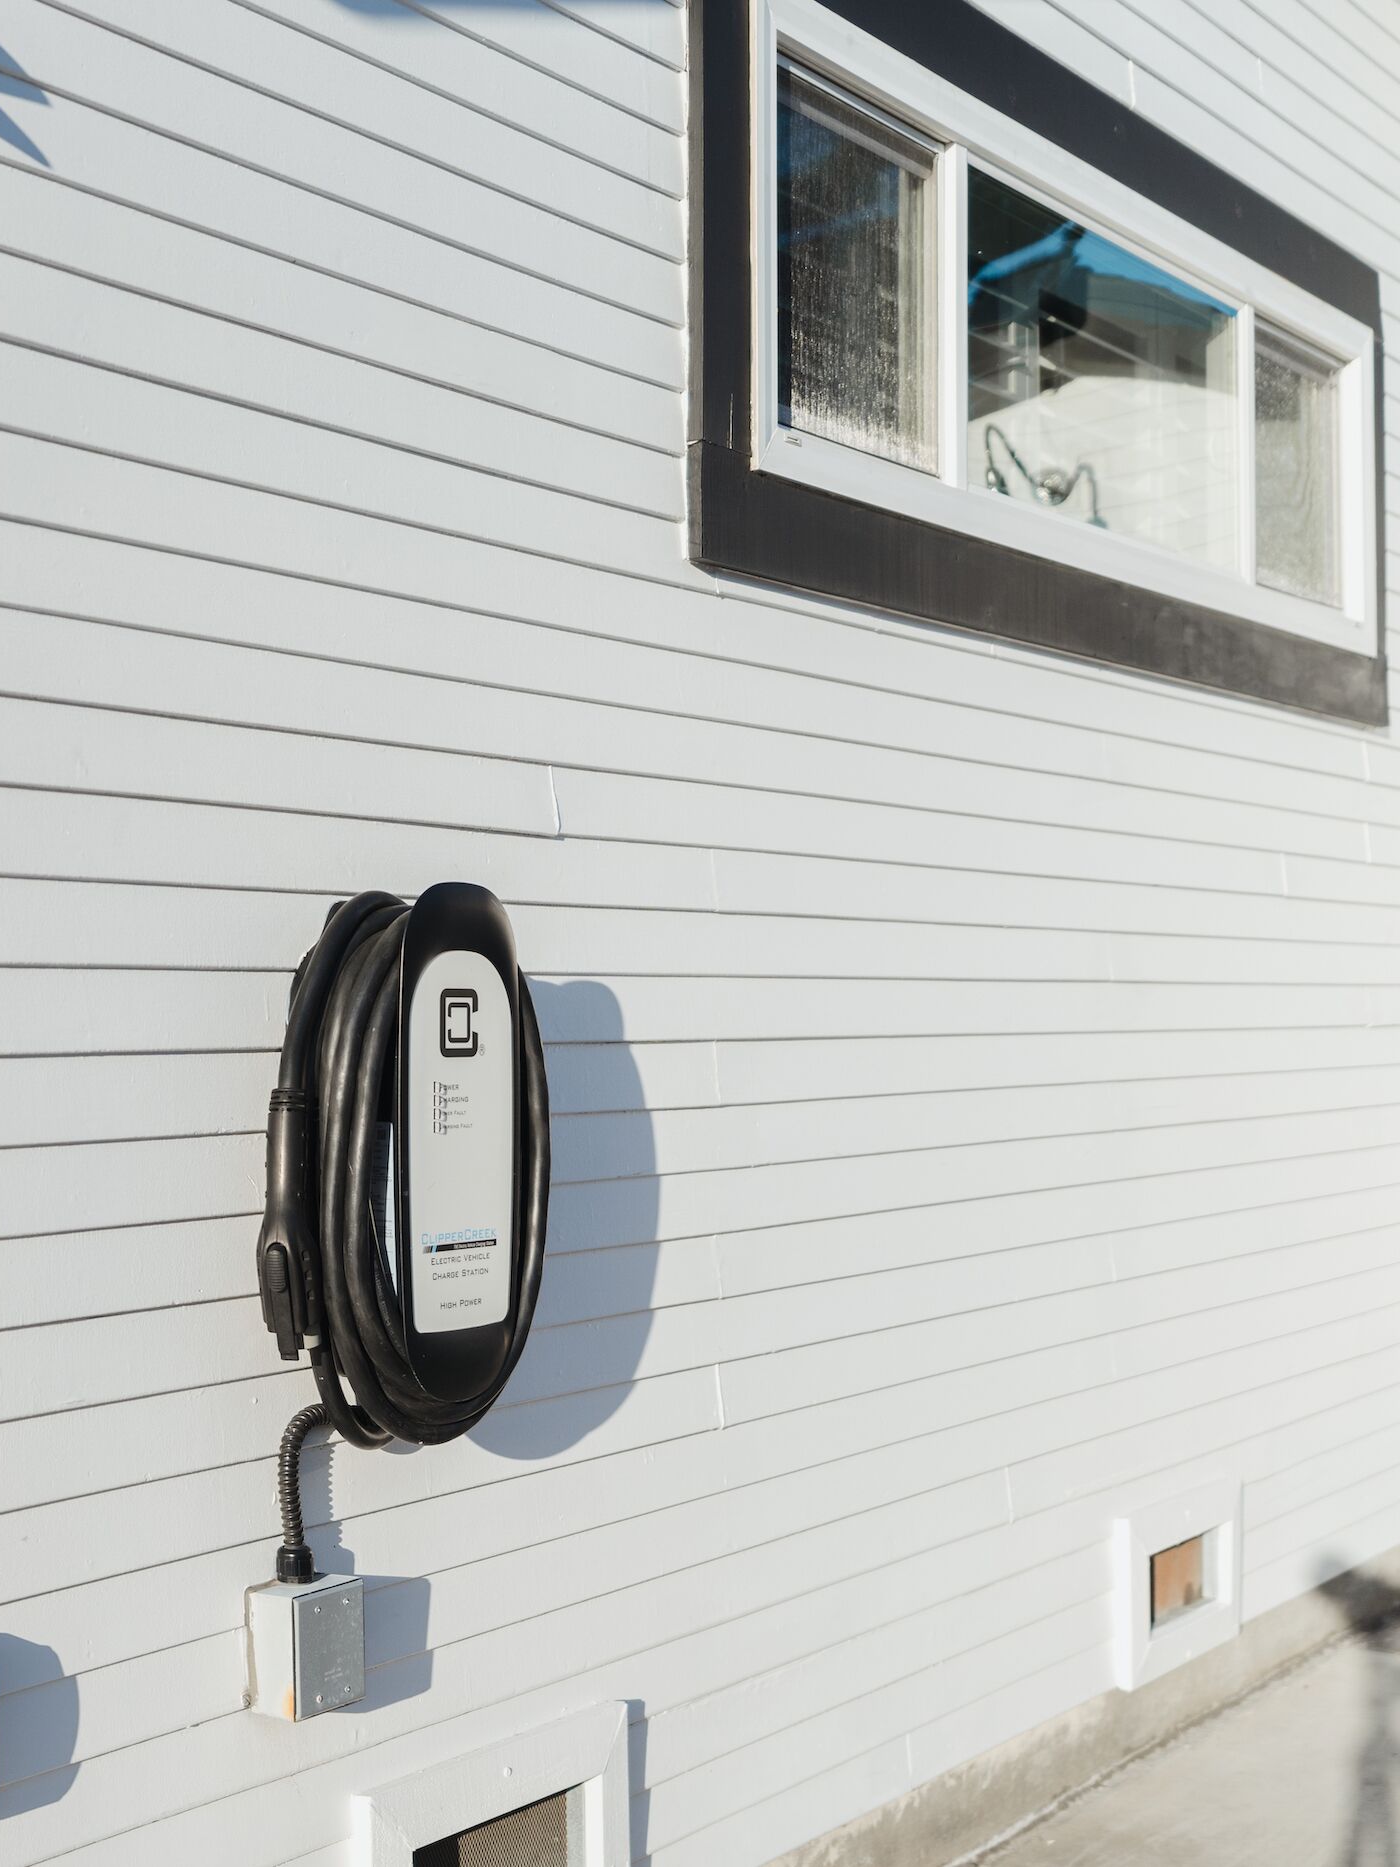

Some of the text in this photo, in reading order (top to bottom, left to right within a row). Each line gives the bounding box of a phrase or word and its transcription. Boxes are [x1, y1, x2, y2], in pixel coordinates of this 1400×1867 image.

[431, 1252, 490, 1266] ELECTRIC VEHICLE
[432, 1267, 489, 1281] CHARGE STATION
[440, 1298, 482, 1310] HIGH POWER
